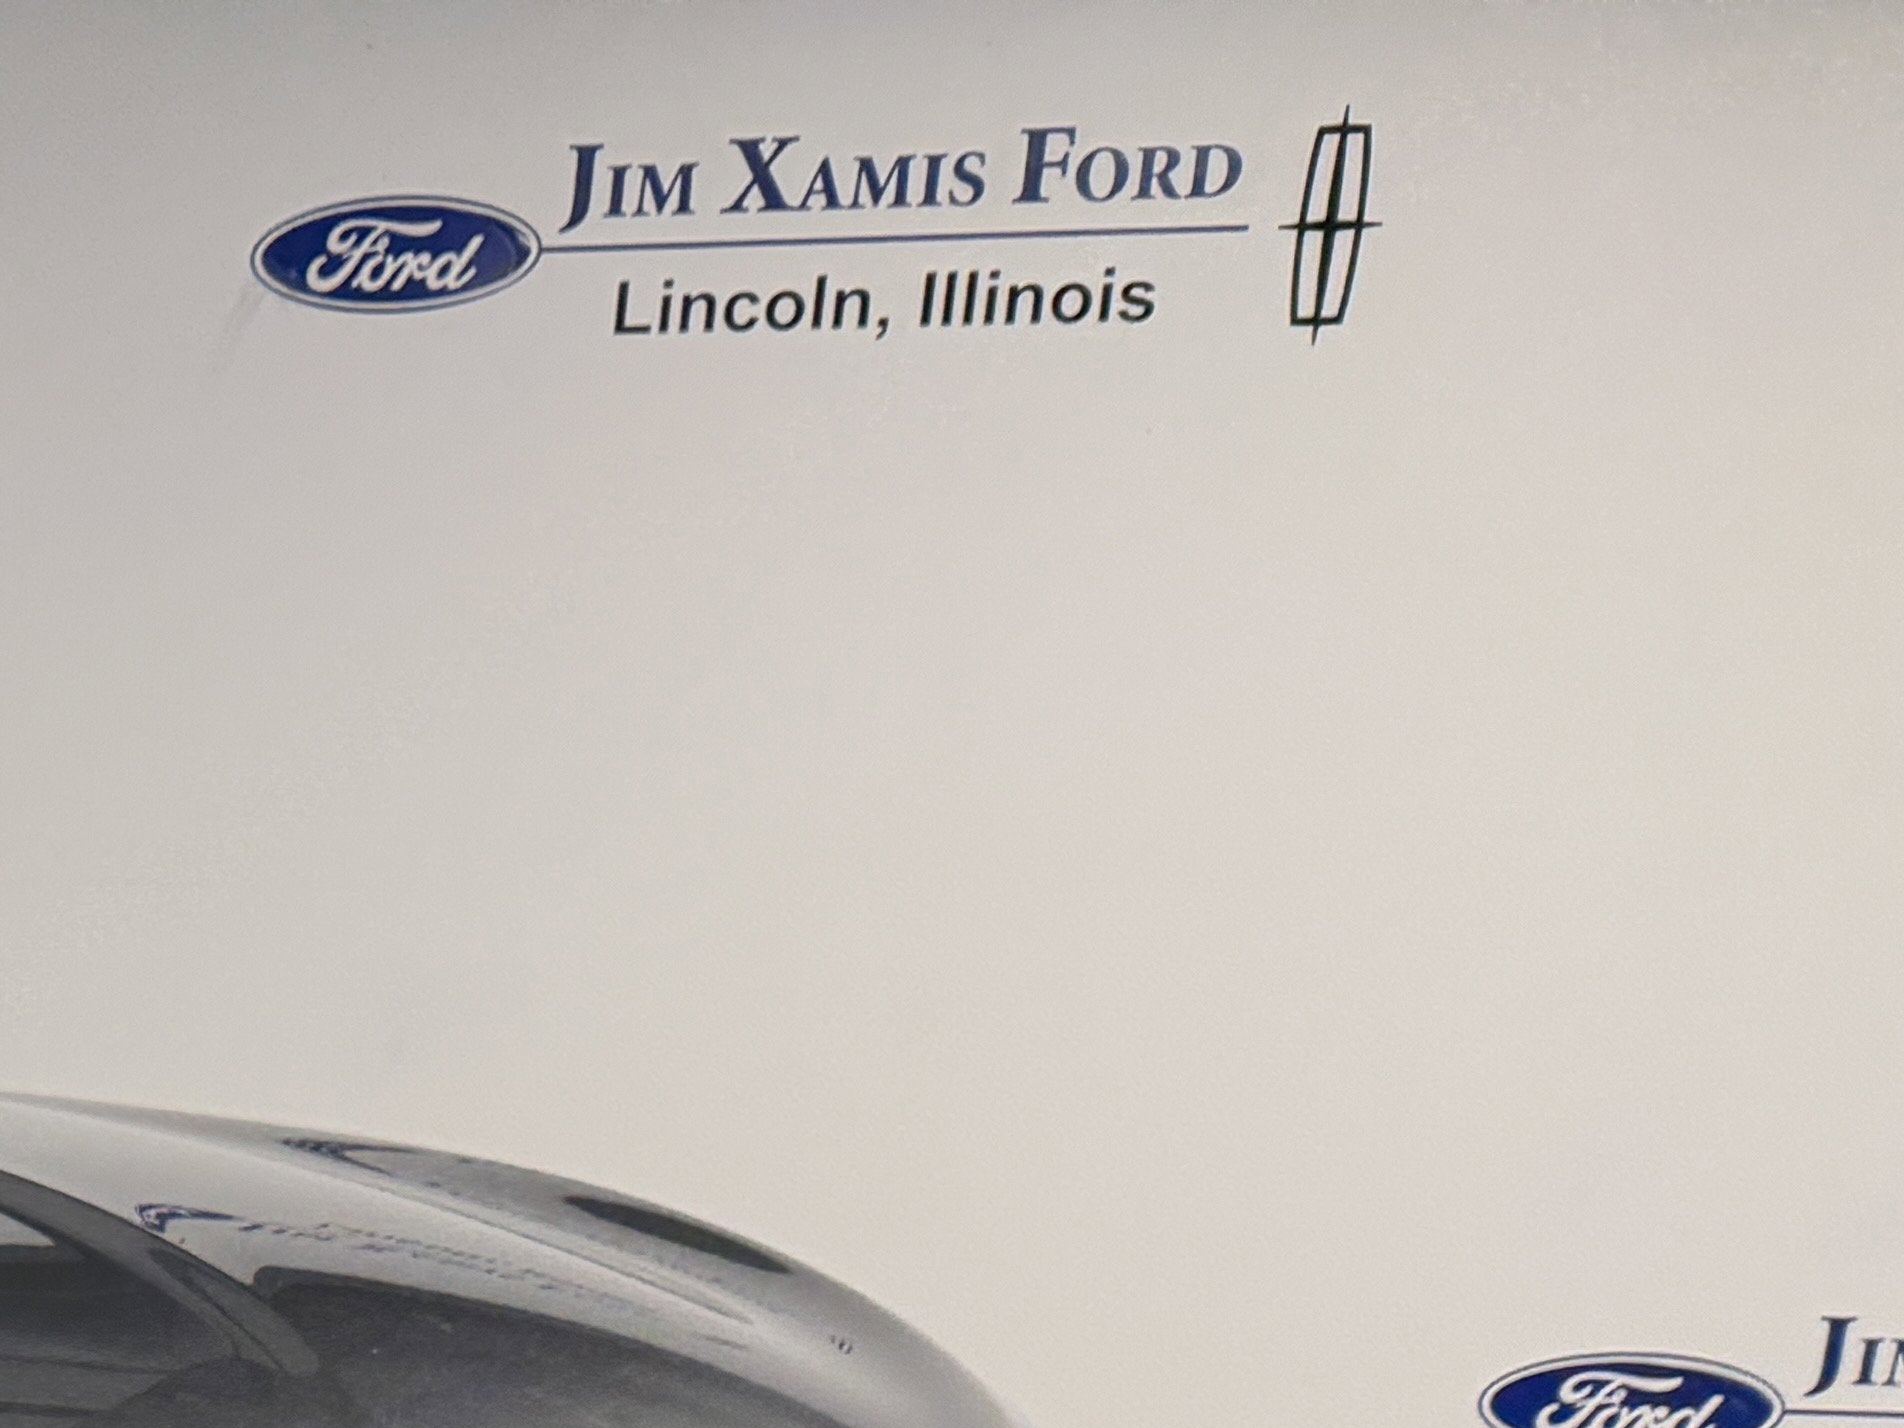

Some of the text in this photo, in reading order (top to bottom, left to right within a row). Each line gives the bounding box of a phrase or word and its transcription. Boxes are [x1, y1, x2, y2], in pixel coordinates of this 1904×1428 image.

[558, 126, 1245, 234] JIM XAMIS FORD
[305, 217, 483, 296] Ford
[613, 265, 1157, 341] Lincoln, Illinois
